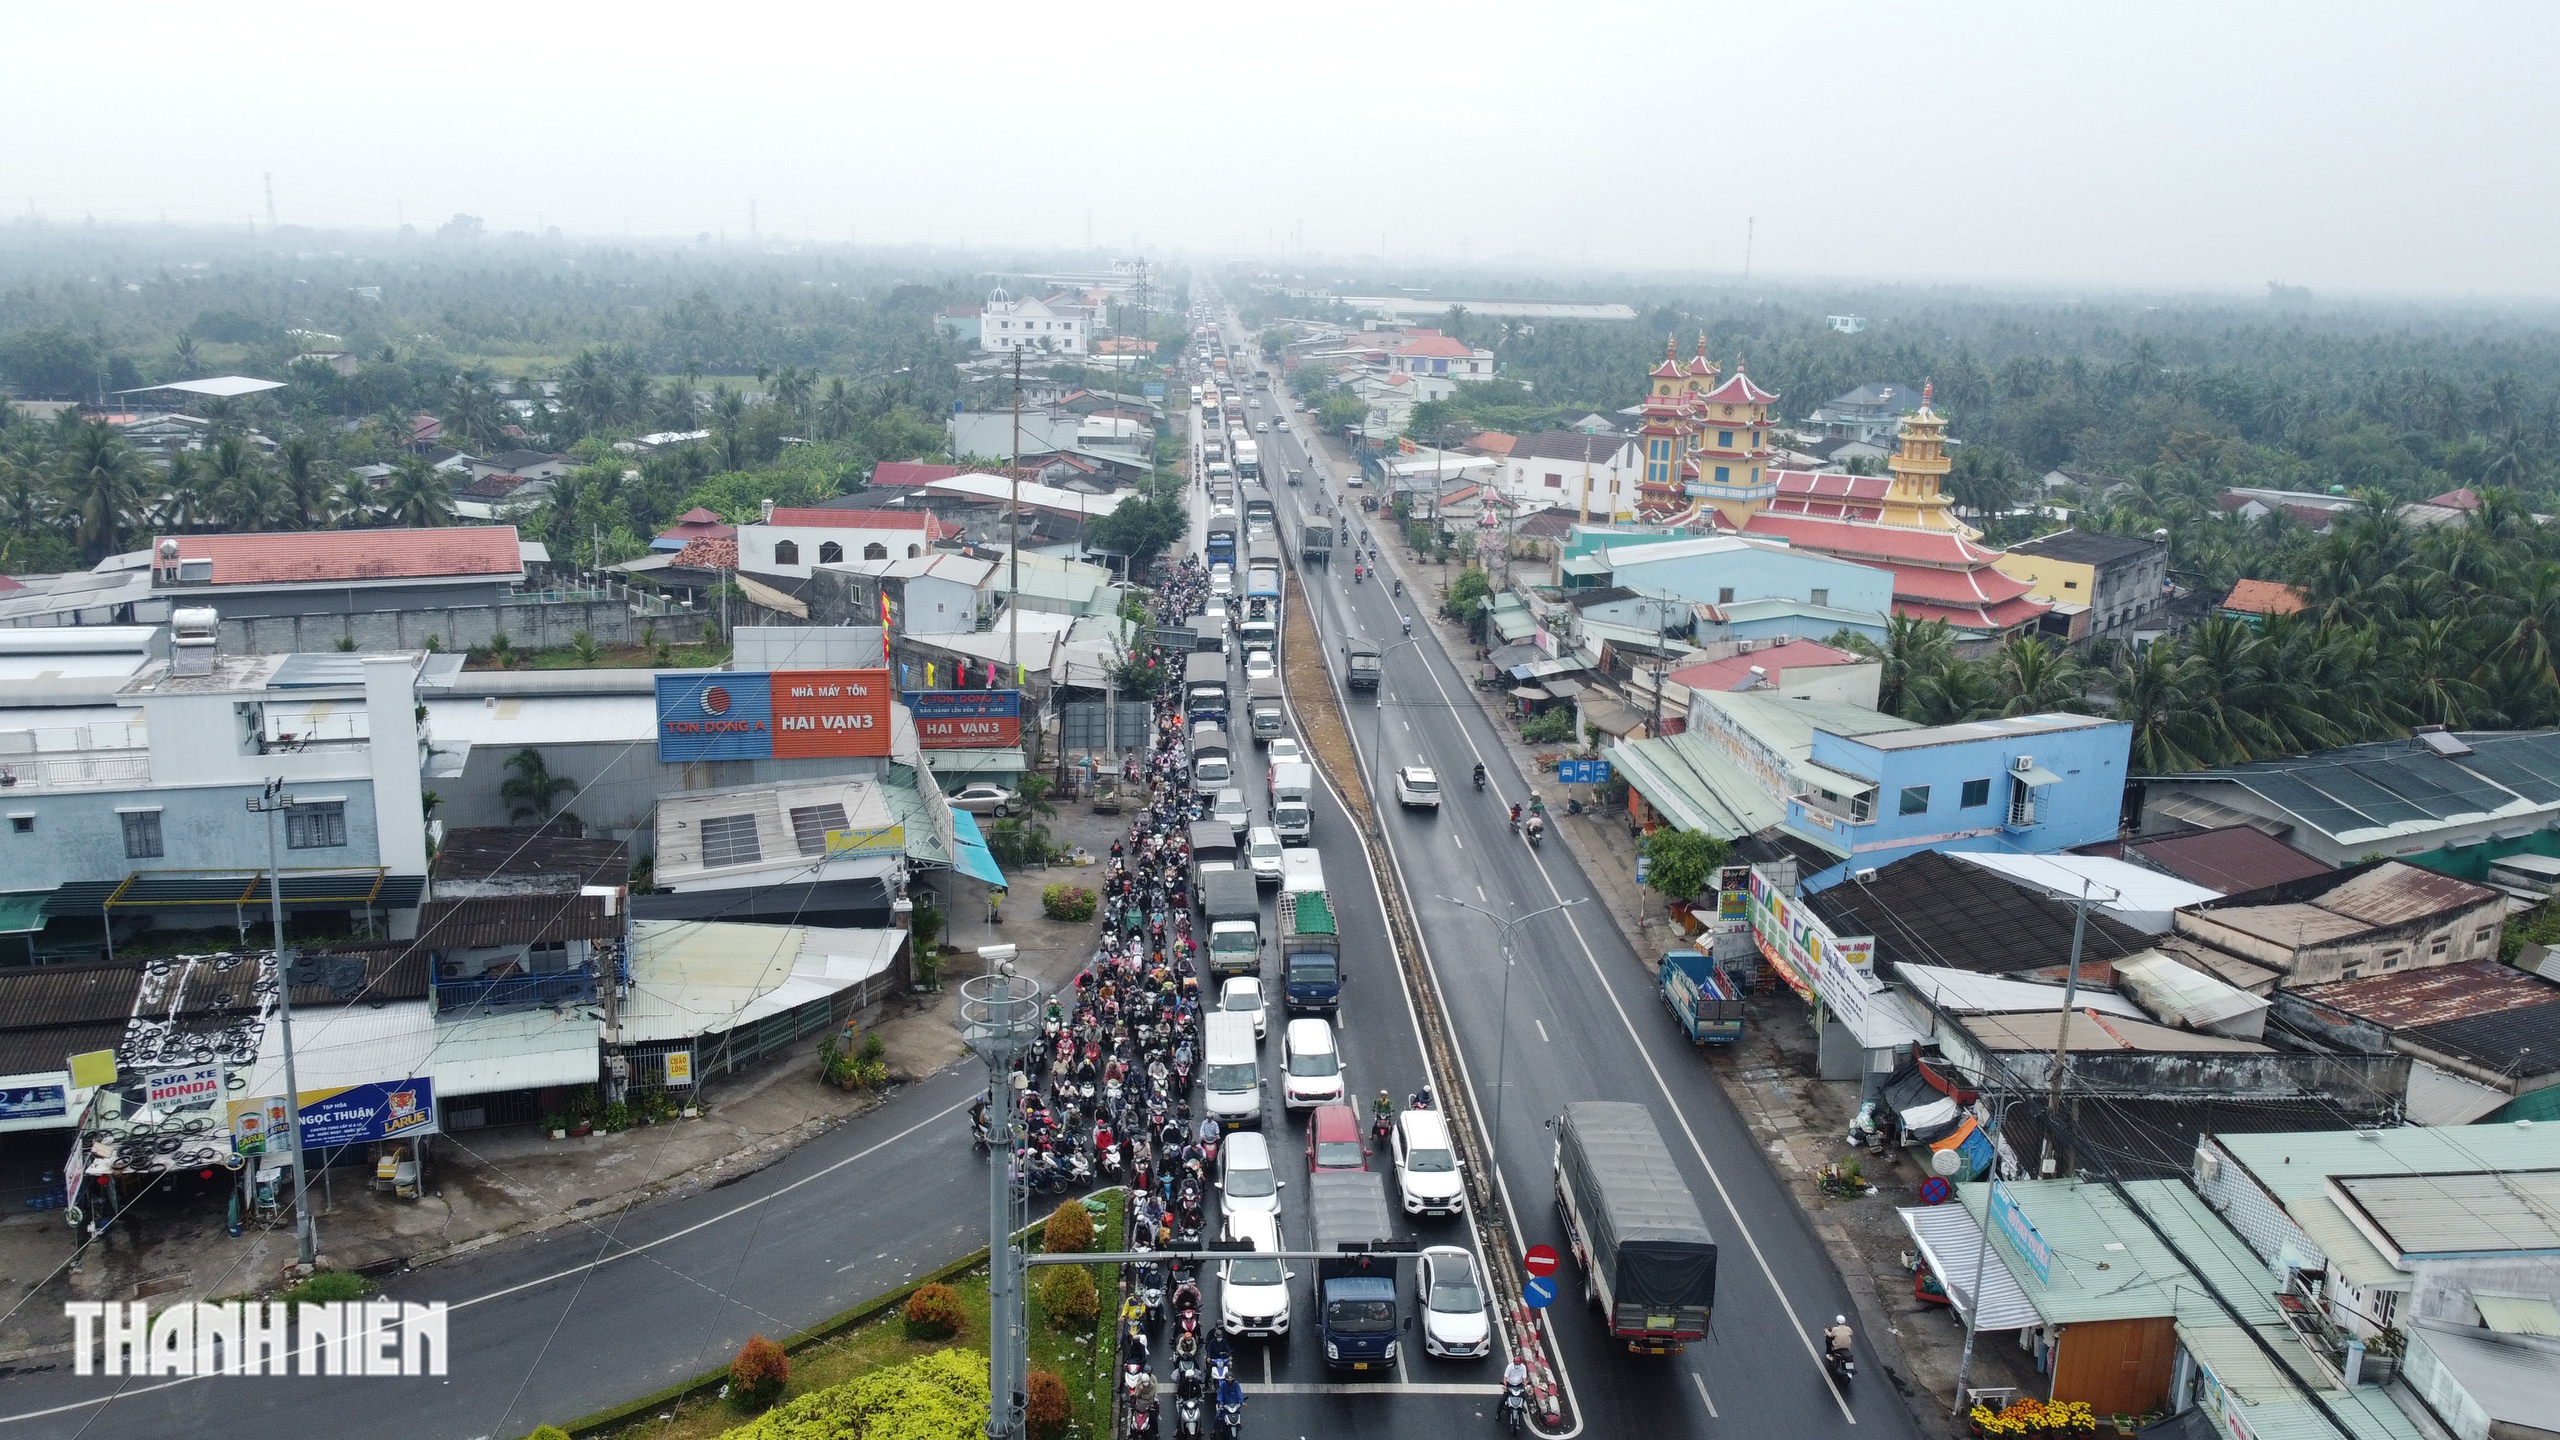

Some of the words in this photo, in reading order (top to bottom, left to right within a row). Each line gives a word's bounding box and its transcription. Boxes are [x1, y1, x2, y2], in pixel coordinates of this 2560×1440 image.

[791, 684, 814, 697] NHÀ
[818, 683, 841, 697] MÁY
[846, 683, 868, 697] TÔN
[782, 715, 815, 731] HAI
[926, 723, 953, 735] HAI
[150, 1074, 188, 1087] SỬA
[194, 1068, 217, 1080] XE
[152, 1079, 217, 1101] HONDA
[152, 1100, 168, 1109] TAY
[170, 1098, 182, 1106] GA
[191, 1094, 203, 1102] XE
[298, 1113, 331, 1125] NGỌC
[333, 1107, 374, 1120] THUẬN
[384, 1110, 426, 1133] LARUE
[238, 1132, 266, 1148] LARUE
